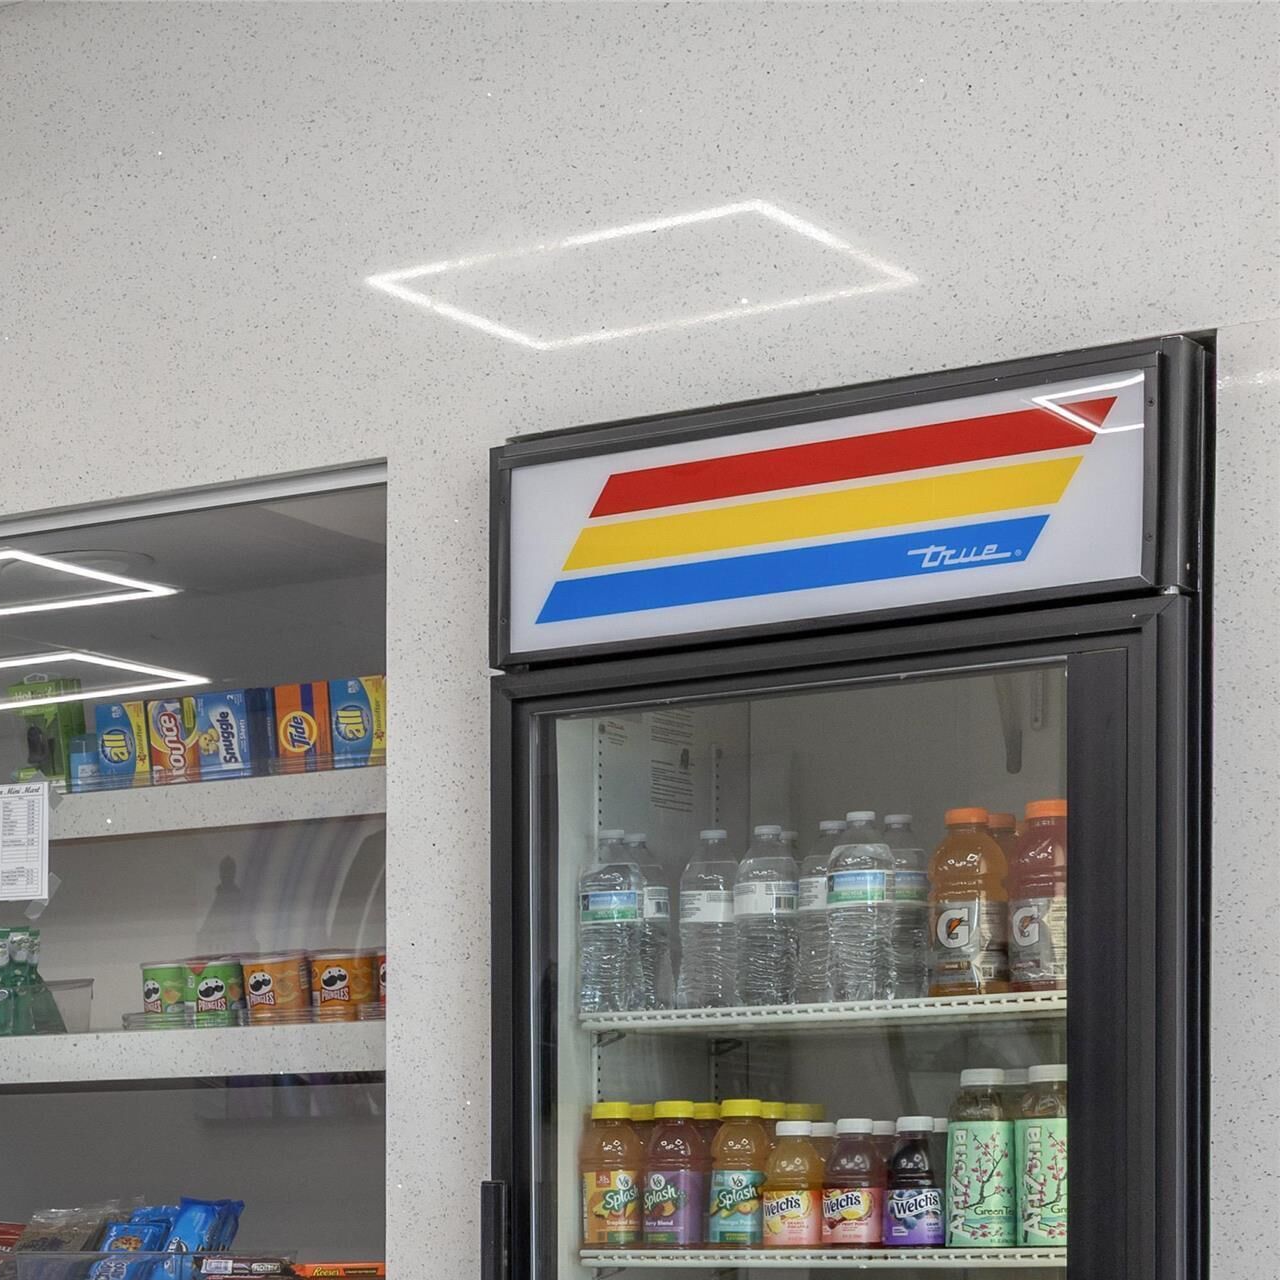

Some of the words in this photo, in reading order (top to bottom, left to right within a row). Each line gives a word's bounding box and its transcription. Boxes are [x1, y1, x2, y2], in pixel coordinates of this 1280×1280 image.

[217, 711, 239, 763] Snuggle
[288, 716, 311, 748] Tide
[937, 908, 971, 949] G
[197, 998, 226, 1013] PRINGLES
[322, 987, 349, 1002] PRINGLES
[719, 1185, 757, 1209] Splash
[765, 1196, 801, 1217] Welch's
[824, 1194, 861, 1215] Welch's
[895, 1191, 939, 1215] Welch's
[974, 1205, 1001, 1216] Green
